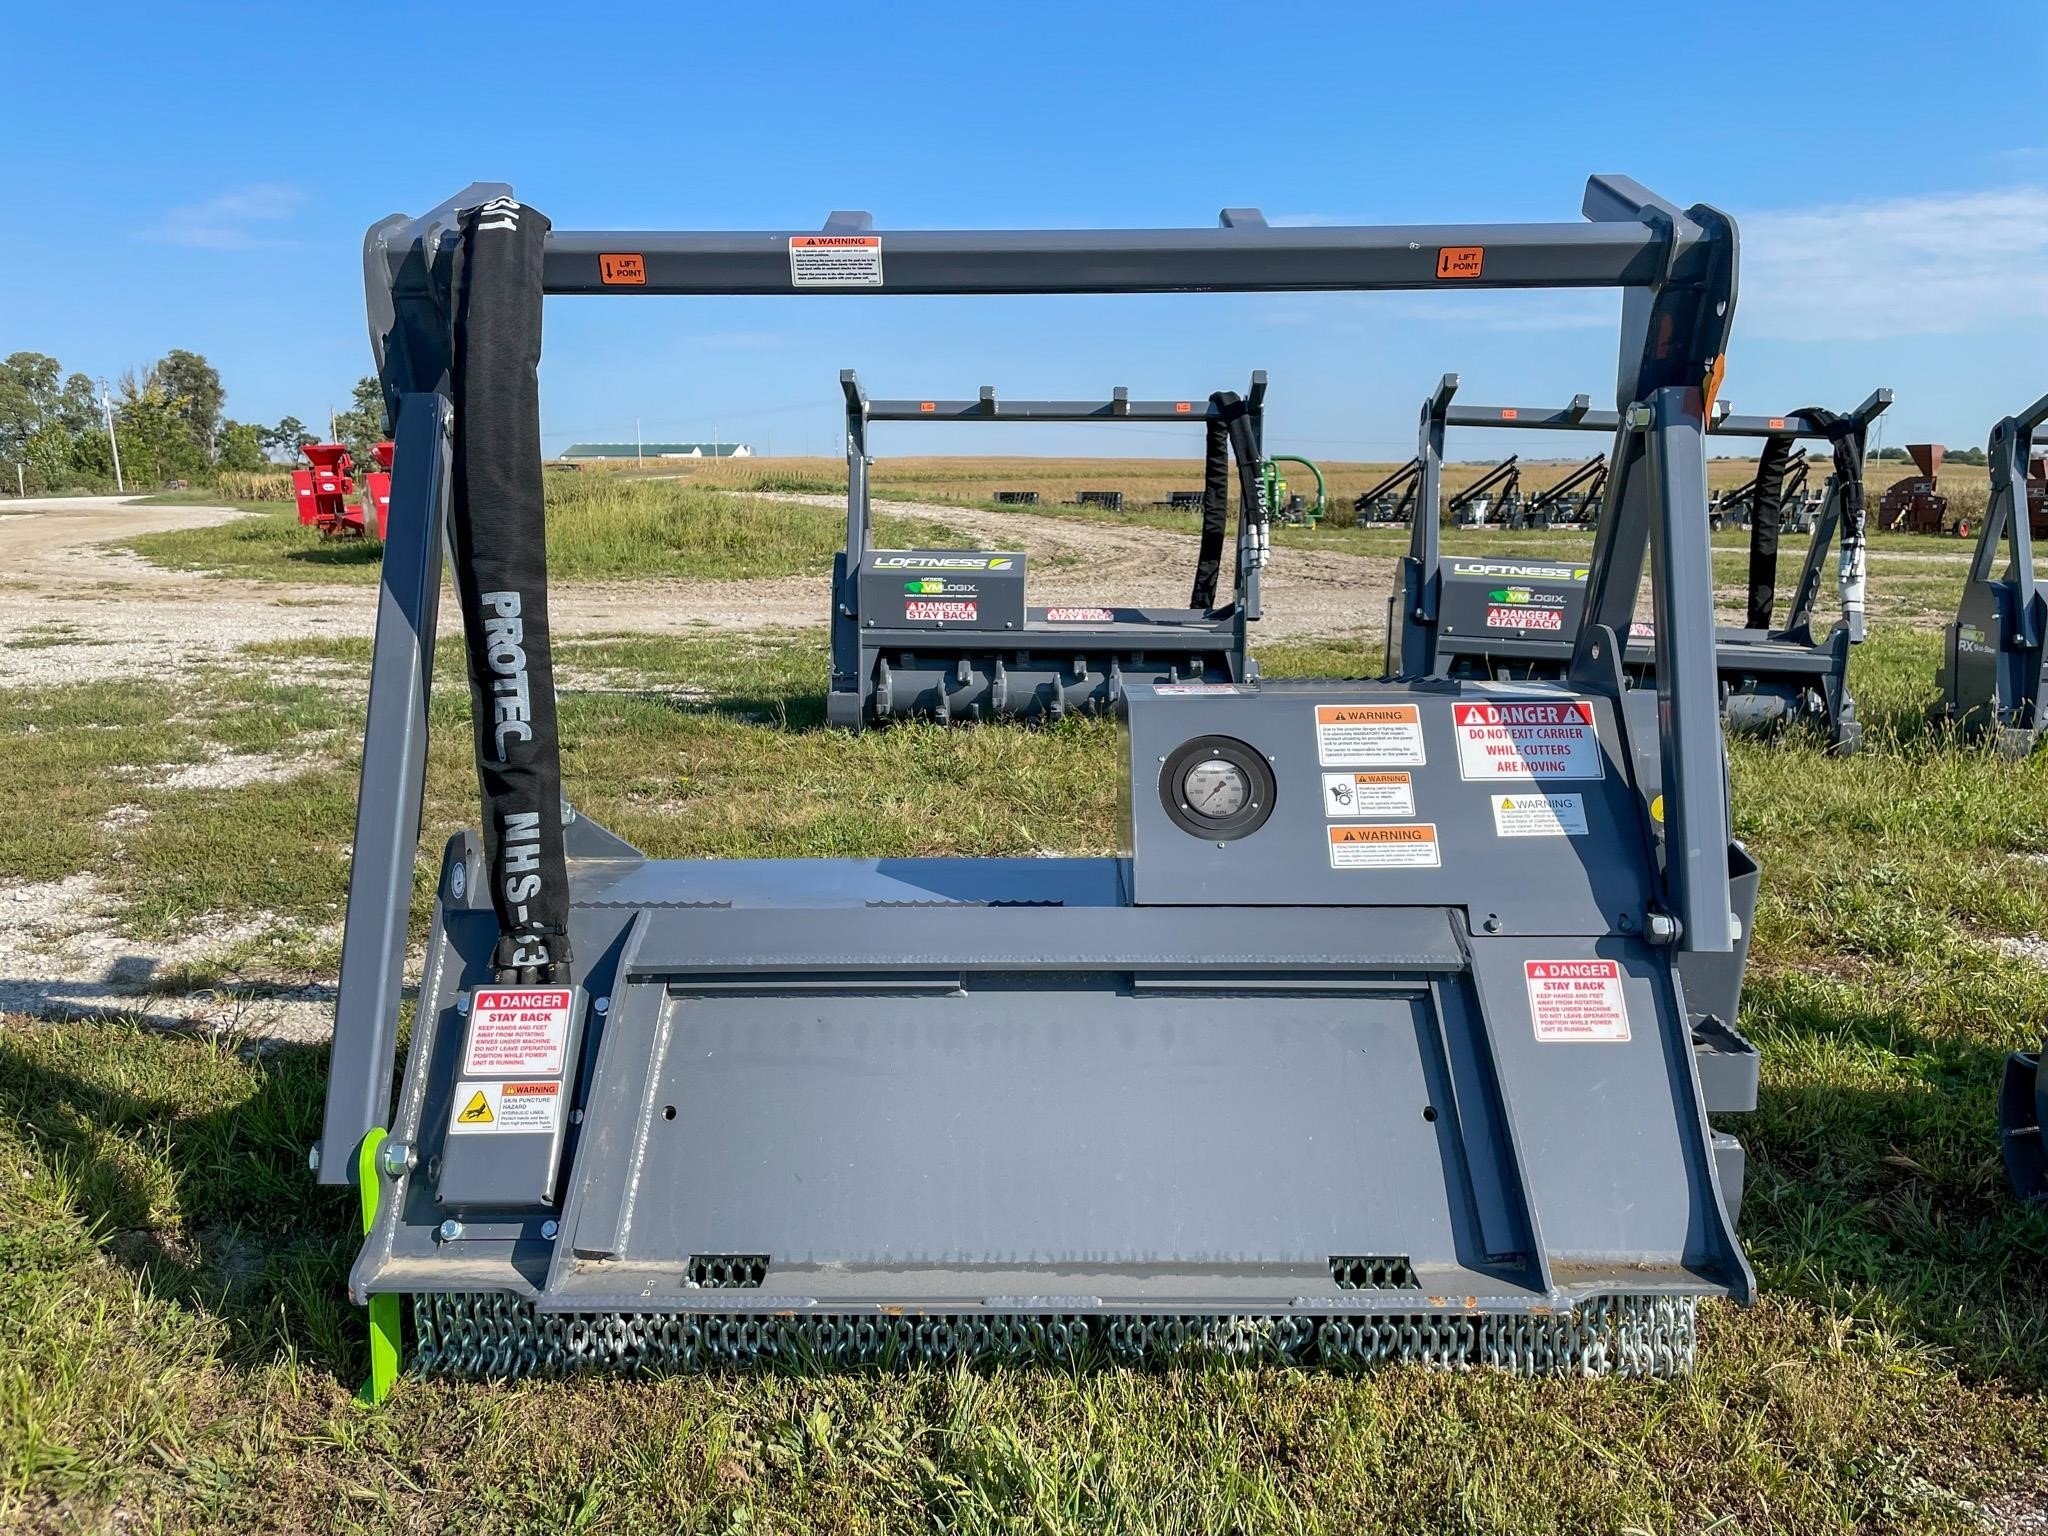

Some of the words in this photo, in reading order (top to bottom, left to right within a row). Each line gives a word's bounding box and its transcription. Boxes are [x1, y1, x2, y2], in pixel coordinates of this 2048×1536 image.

[619, 260, 637, 268] LIFT
[1453, 262, 1479, 270] POINT
[874, 557, 989, 568] LOFTNESS
[1454, 563, 1572, 577] LOFTNESS
[918, 602, 967, 611] DANGER
[909, 611, 938, 619] STAY
[943, 611, 974, 619] BACK
[1500, 609, 1551, 620] DANGER
[1490, 618, 1521, 627] STAY
[1525, 620, 1558, 629] BACK
[1958, 640, 1974, 652] RX
[1348, 712, 1402, 720] WARNING
[1486, 706, 1560, 724] DANGER
[1469, 729, 1484, 739] DO
[1487, 729, 1509, 739] NOT
[1512, 729, 1534, 739] EXIT
[1536, 728, 1584, 739] CARRIER
[1486, 745, 1522, 755] WHILE
[1524, 745, 1571, 755] CUTTERS
[1497, 762, 1519, 772] ARE
[1521, 761, 1566, 772] MOVING
[1358, 830, 1422, 841] WARNING
[1550, 965, 1611, 976] DANGER
[1543, 982, 1571, 990] STAY
[1574, 982, 1606, 990] BACK
[500, 995, 562, 1007] DANGER
[489, 1013, 517, 1022] STAY
[520, 1013, 552, 1022] BACK
[516, 1086, 555, 1094] WARNING
